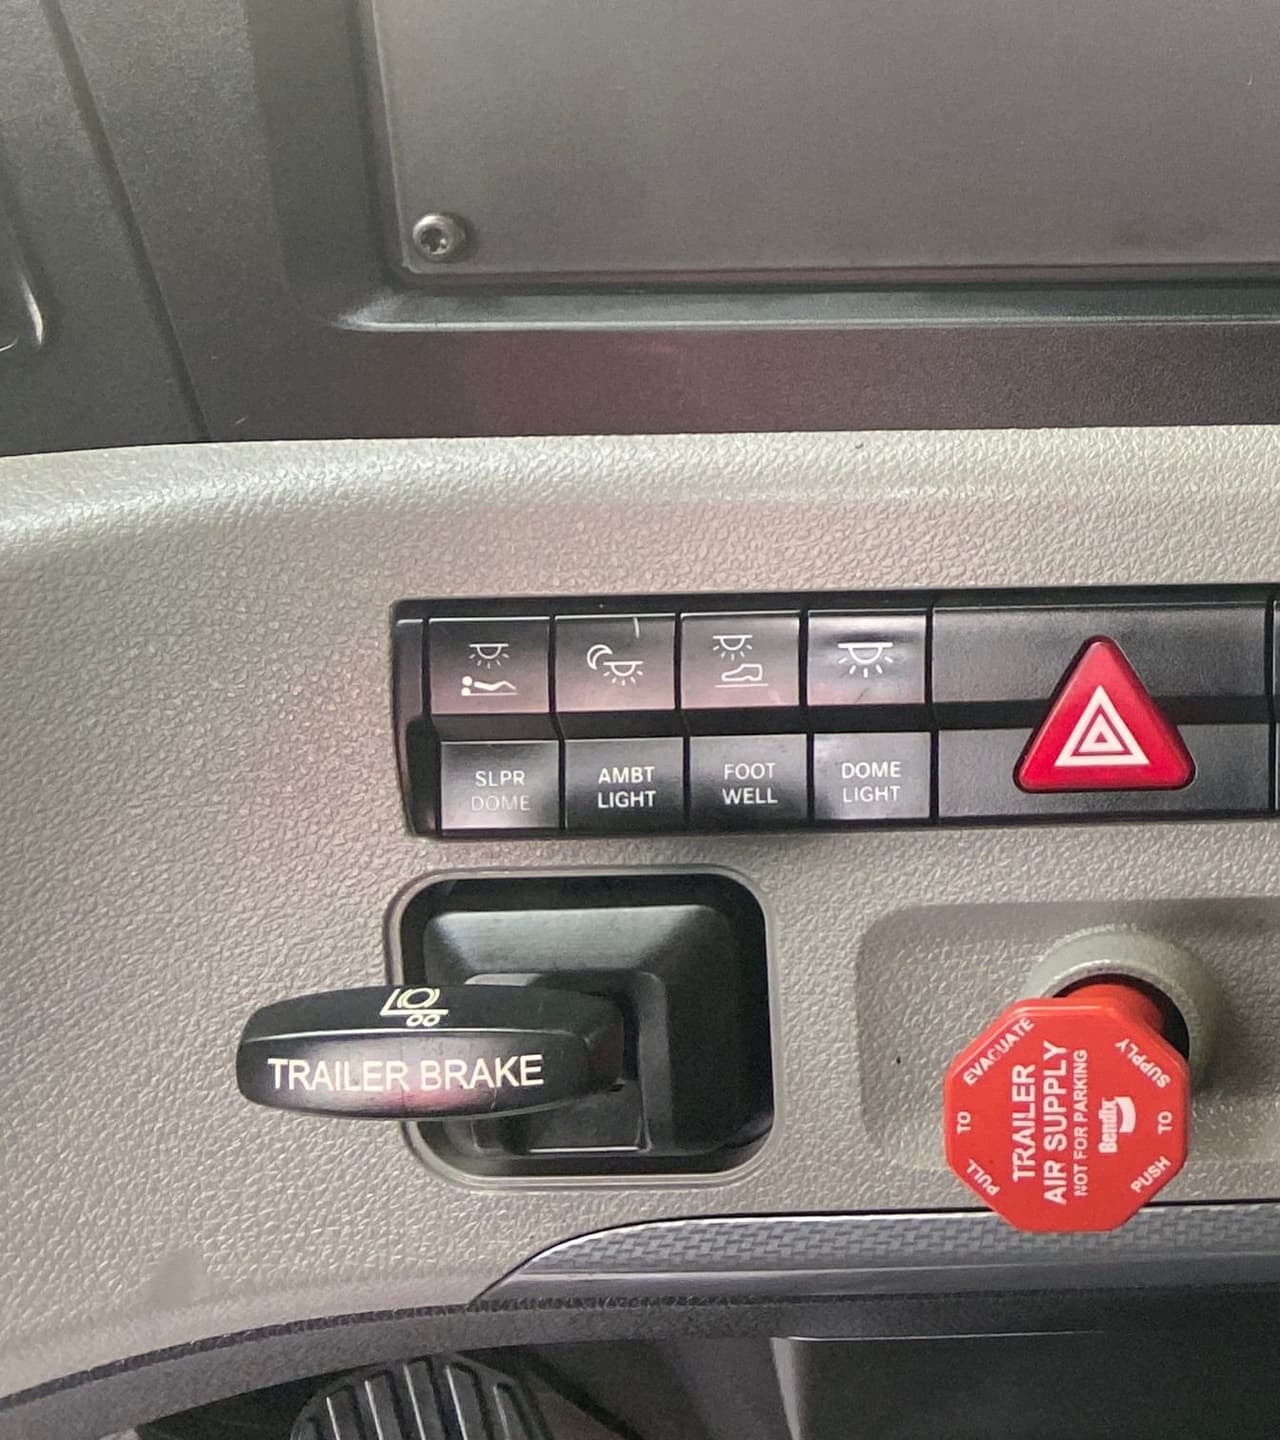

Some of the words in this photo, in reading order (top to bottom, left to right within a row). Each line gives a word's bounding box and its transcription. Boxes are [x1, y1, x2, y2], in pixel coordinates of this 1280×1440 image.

[475, 769, 526, 788] SLPR
[598, 766, 655, 784] AMBT
[724, 763, 776, 780] FOOT
[841, 761, 901, 779] DOME
[471, 793, 530, 812] DOME
[597, 790, 656, 809] LIGHT
[722, 786, 778, 805] WELL
[843, 785, 900, 803] LIGHT
[963, 1017, 1034, 1085] EVACUATE
[1115, 1039, 1171, 1088] SUPPLY
[268, 1058, 411, 1091] TRAILER
[421, 1054, 544, 1090] BRAKE
[1073, 1049, 1088, 1122] PARKING
[1043, 1040, 1068, 1151] SUPPLY
[956, 1111, 971, 1134] TO
[1012, 1064, 1036, 1182] TRAILER
[1098, 1097, 1118, 1153] Bendix
[1157, 1111, 1173, 1135] TO
[1074, 1127, 1088, 1160] FOR
[966, 1159, 1000, 1196] PULL
[1043, 1160, 1067, 1205] AIR
[1074, 1163, 1088, 1196] NOT
[1130, 1156, 1171, 1193] PUSH
